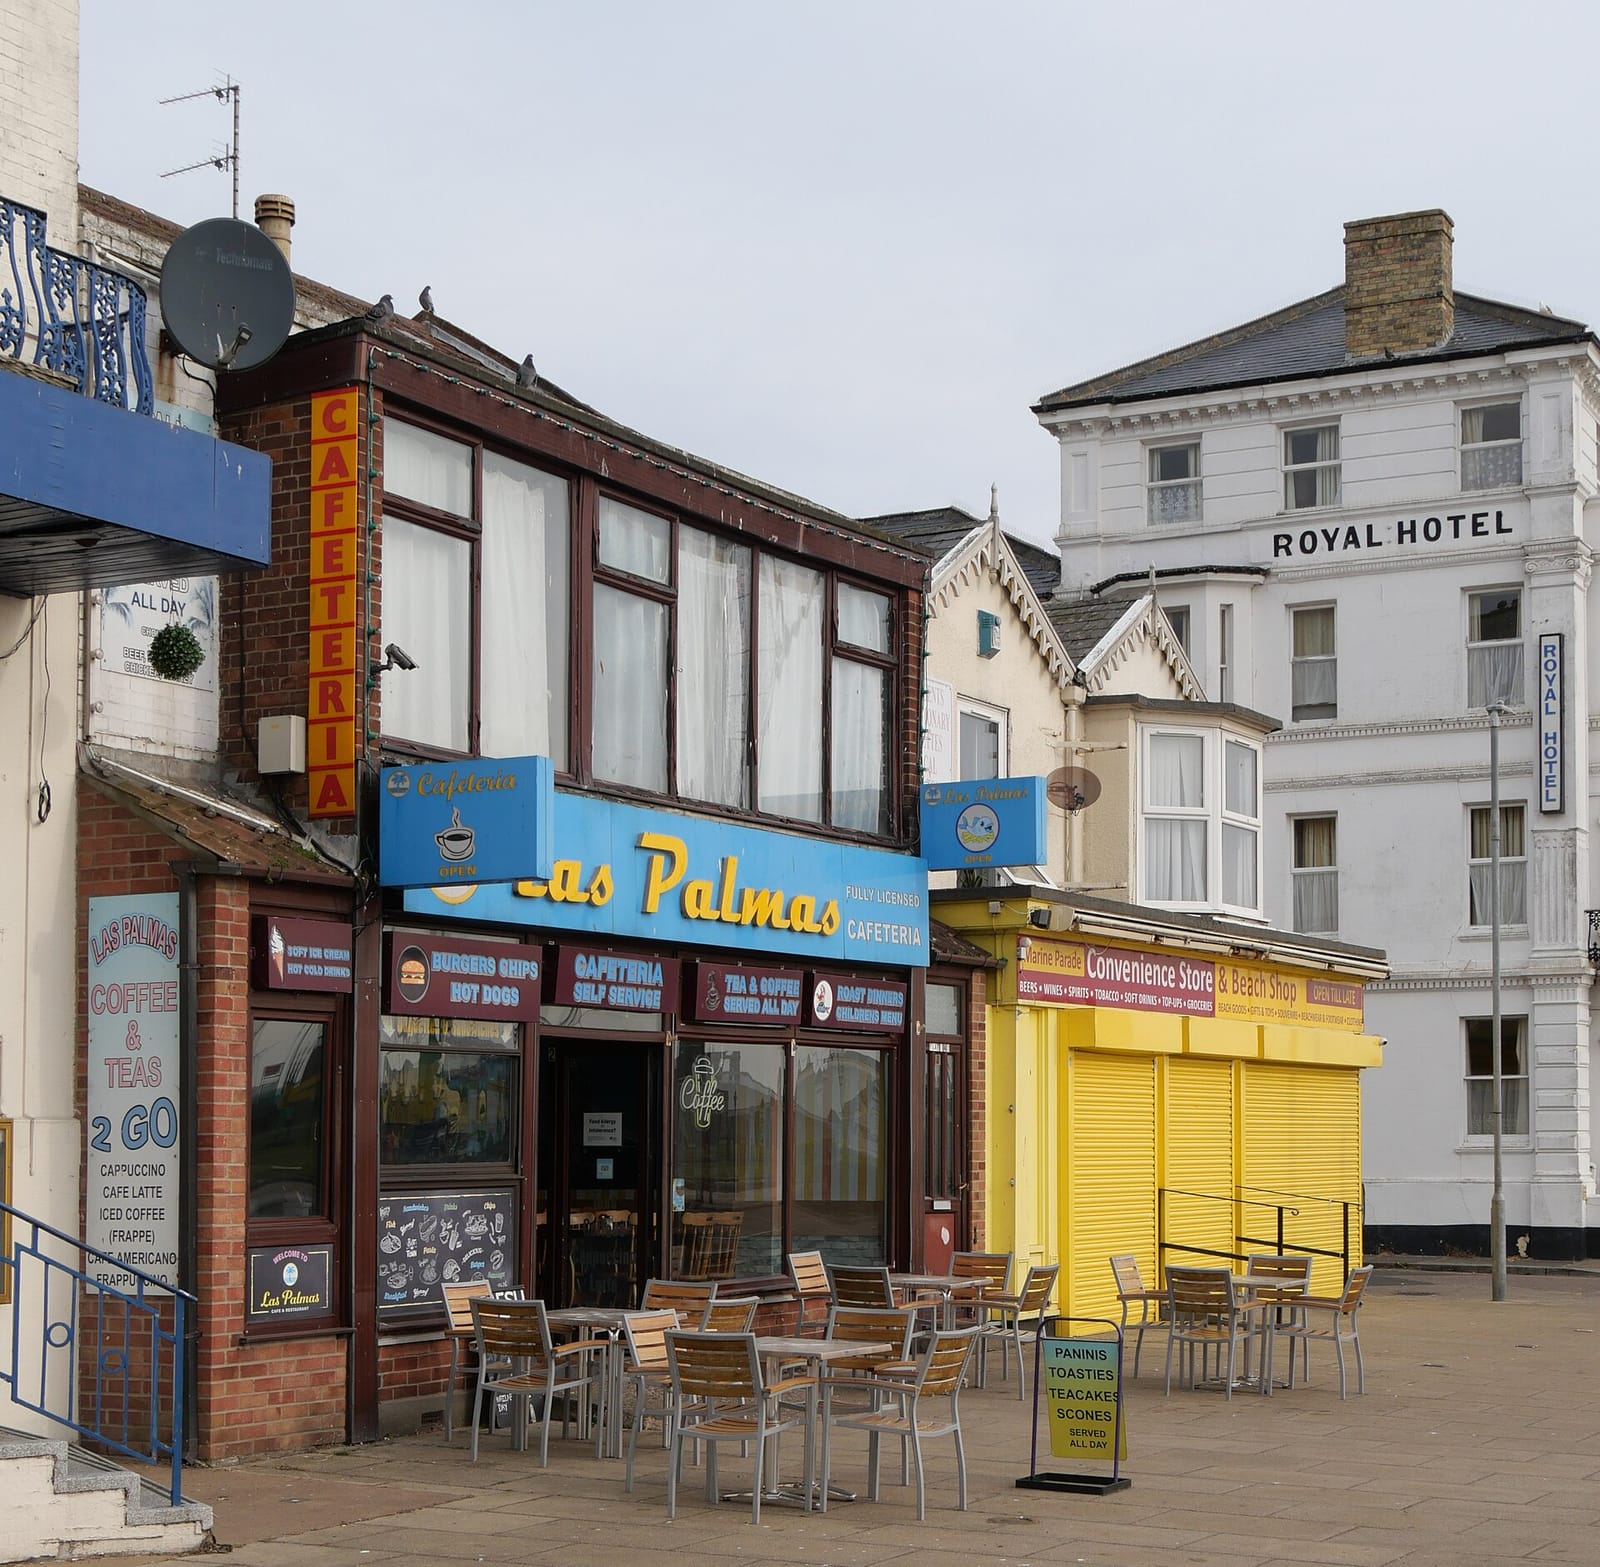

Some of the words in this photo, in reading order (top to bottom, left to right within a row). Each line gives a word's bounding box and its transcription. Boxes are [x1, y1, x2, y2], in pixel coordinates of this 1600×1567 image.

[1273, 524, 1382, 557] ROYAL
[1397, 511, 1513, 544] HOTEL
[131, 592, 157, 610] ALL
[162, 598, 186, 617] DAY
[317, 399, 349, 809] CAFETERIA
[1543, 645, 1557, 715] ROYAL
[1544, 732, 1557, 802] HOTEL
[418, 769, 517, 801] Cafeteria
[943, 787, 969, 804] Las
[974, 784, 1029, 802] Palmas
[963, 853, 993, 864] OPEN
[438, 864, 477, 878] OPEN
[638, 832, 841, 937] Palmas
[846, 886, 874, 902] FULLY
[877, 888, 920, 908] LICENSED
[91, 920, 121, 965] LAS
[121, 915, 178, 960] PALMAS
[847, 919, 922, 947] CAFETERIA
[287, 945, 308, 958] SOFT
[309, 946, 323, 959] ICE
[323, 948, 350, 961] CREAM
[1024, 947, 1052, 966] Marine
[1055, 950, 1082, 970] Parade
[287, 963, 303, 975] HOT
[304, 964, 323, 976] COLD
[324, 966, 351, 978] DRINKS
[431, 951, 496, 977] BURGERS
[498, 957, 539, 981] CHIPS
[574, 953, 664, 987] CAFETERIA
[725, 974, 747, 994] TEA
[749, 976, 758, 994] &
[760, 977, 800, 998] COFFEE
[1087, 948, 1176, 988] Convenience
[1179, 961, 1213, 992] Store
[1218, 966, 1228, 994] &
[1232, 968, 1266, 998] Beach
[1269, 969, 1297, 1008] Shop
[91, 981, 178, 1015] COFFEE
[450, 981, 479, 1004] HOT
[481, 984, 519, 1007] DOGS
[573, 981, 606, 1005] SELF
[608, 985, 661, 1010] SERVICE
[837, 985, 867, 1004] ROAST
[867, 988, 905, 1007] DINNERS
[1020, 981, 1038, 993] BEERS
[1044, 983, 1063, 996] WINES
[1068, 985, 1089, 999] SPIRITS
[1094, 988, 1119, 1002] TOBACCO
[1124, 992, 1138, 1004] SOFT
[1138, 993, 1157, 1005] DRINKS
[1162, 996, 1182, 1009] TOP-UPS
[1187, 999, 1213, 1012] GROCERIES
[1313, 985, 1329, 1002] OPEN
[1330, 988, 1341, 1004] TILL
[1342, 989, 1356, 1005] LATE
[723, 996, 760, 1014] SERVED
[761, 998, 780, 1015] ALL
[781, 1000, 800, 1017] DAY
[836, 1007, 879, 1024] CHILDRENS
[880, 1010, 903, 1027] MENU
[1218, 1002, 1231, 1013] BEACH
[1232, 1003, 1247, 1014] GOODS
[126, 1020, 142, 1051] &
[104, 1056, 162, 1088] TEAS
[680, 1076, 725, 1121] Coffee
[91, 1116, 112, 1152] 2
[121, 1096, 178, 1151] GO
[100, 1163, 166, 1177] CAPPUCCINO
[103, 1186, 129, 1199] CAFE
[131, 1186, 163, 1199] LATTE
[100, 1208, 123, 1221] ICED
[125, 1208, 166, 1221] COFFEE
[109, 1230, 155, 1245] (FRAPPE)
[117, 1252, 177, 1264] AMERICANO
[273, 1250, 300, 1264] WELCOME
[300, 1253, 309, 1262] TO
[261, 1291, 280, 1308] Las
[282, 1289, 320, 1306] Palmas
[1055, 1347, 1108, 1361] PANINIS
[1049, 1366, 1114, 1381] TOASTIES
[1049, 1388, 1119, 1402] TEACAKES
[1056, 1408, 1112, 1422] SCONES
[1069, 1428, 1106, 1438] SERVED
[1069, 1439, 1088, 1448] ALL
[1089, 1440, 1108, 1449] DAY
